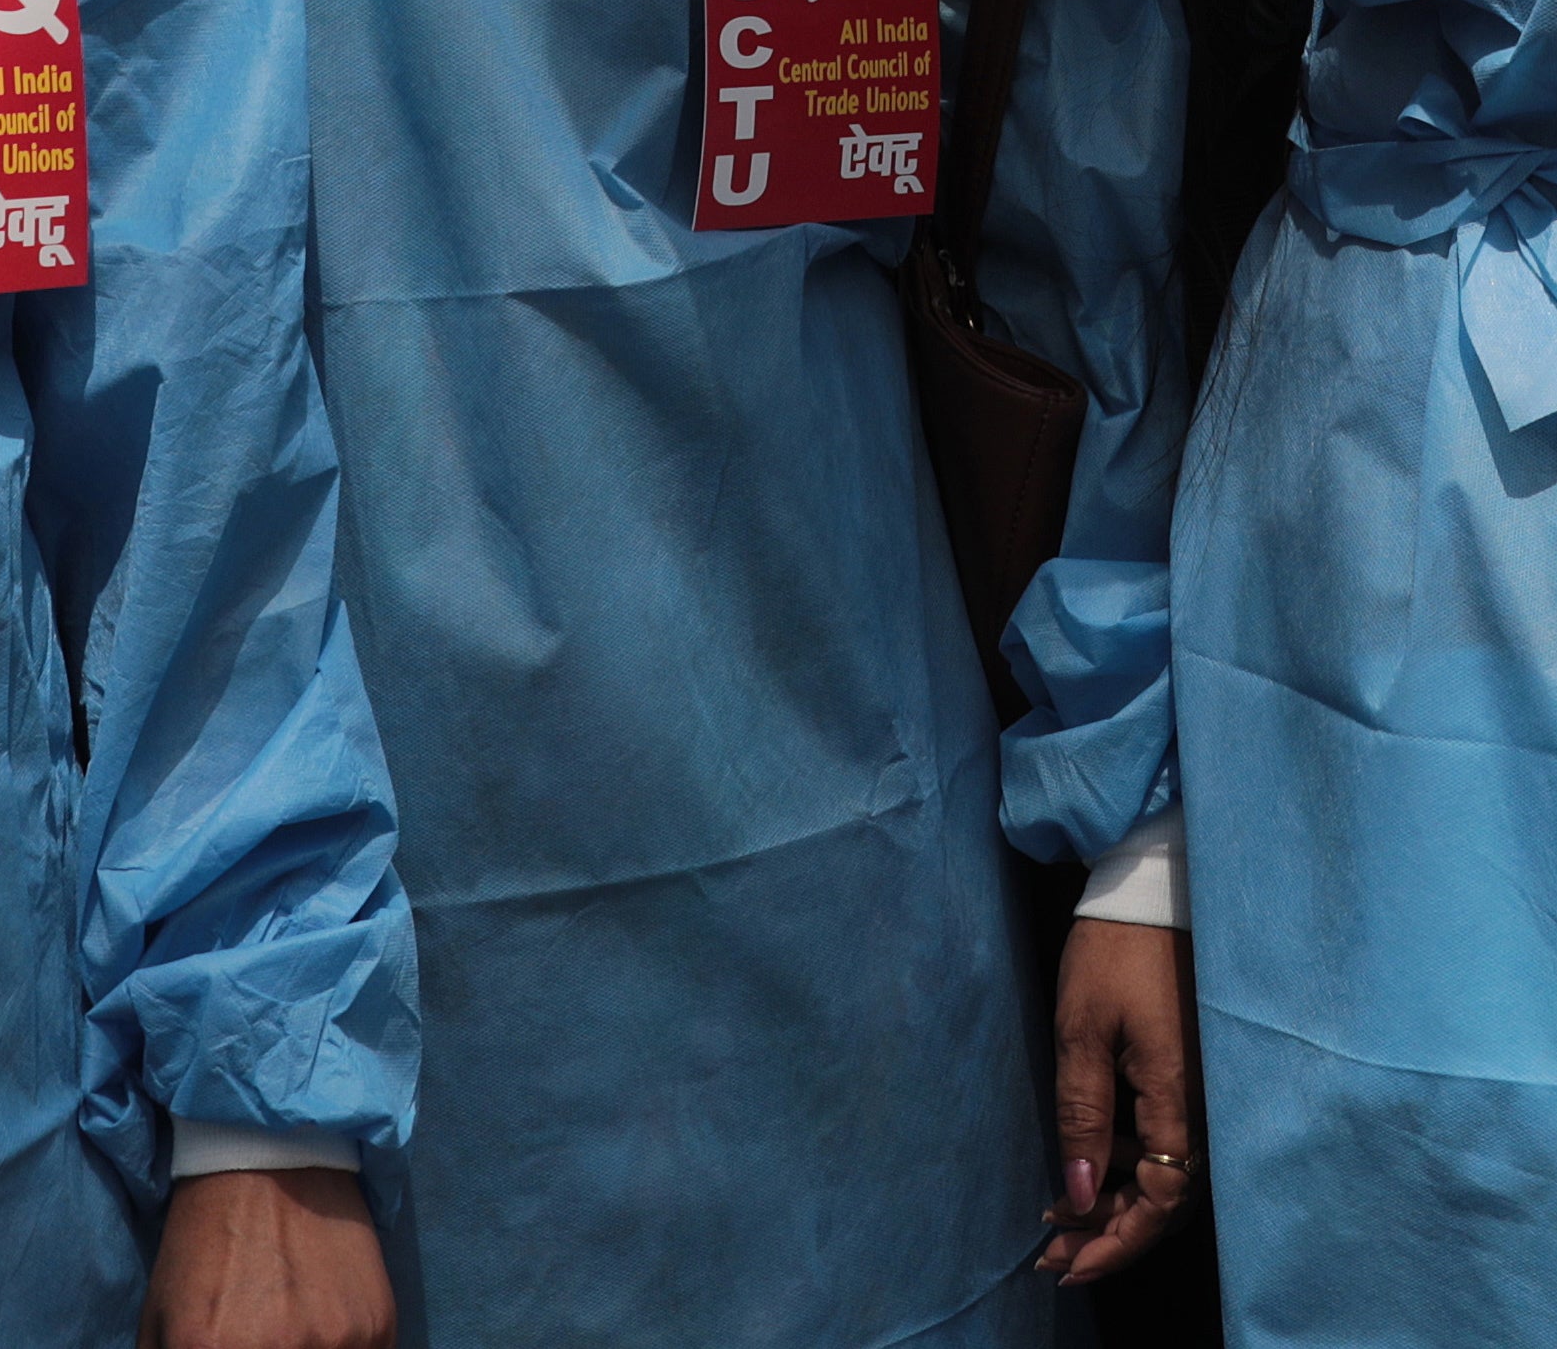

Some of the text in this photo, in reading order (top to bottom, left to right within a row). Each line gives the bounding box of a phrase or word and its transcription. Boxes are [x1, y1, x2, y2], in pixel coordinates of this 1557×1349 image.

[840, 18, 928, 45] All India
[14, 66, 72, 95] India
[778, 50, 931, 84] Central Council of
[805, 87, 930, 117] Trade Unions
[57, 103, 75, 132] of
[2, 143, 75, 175] Unions
